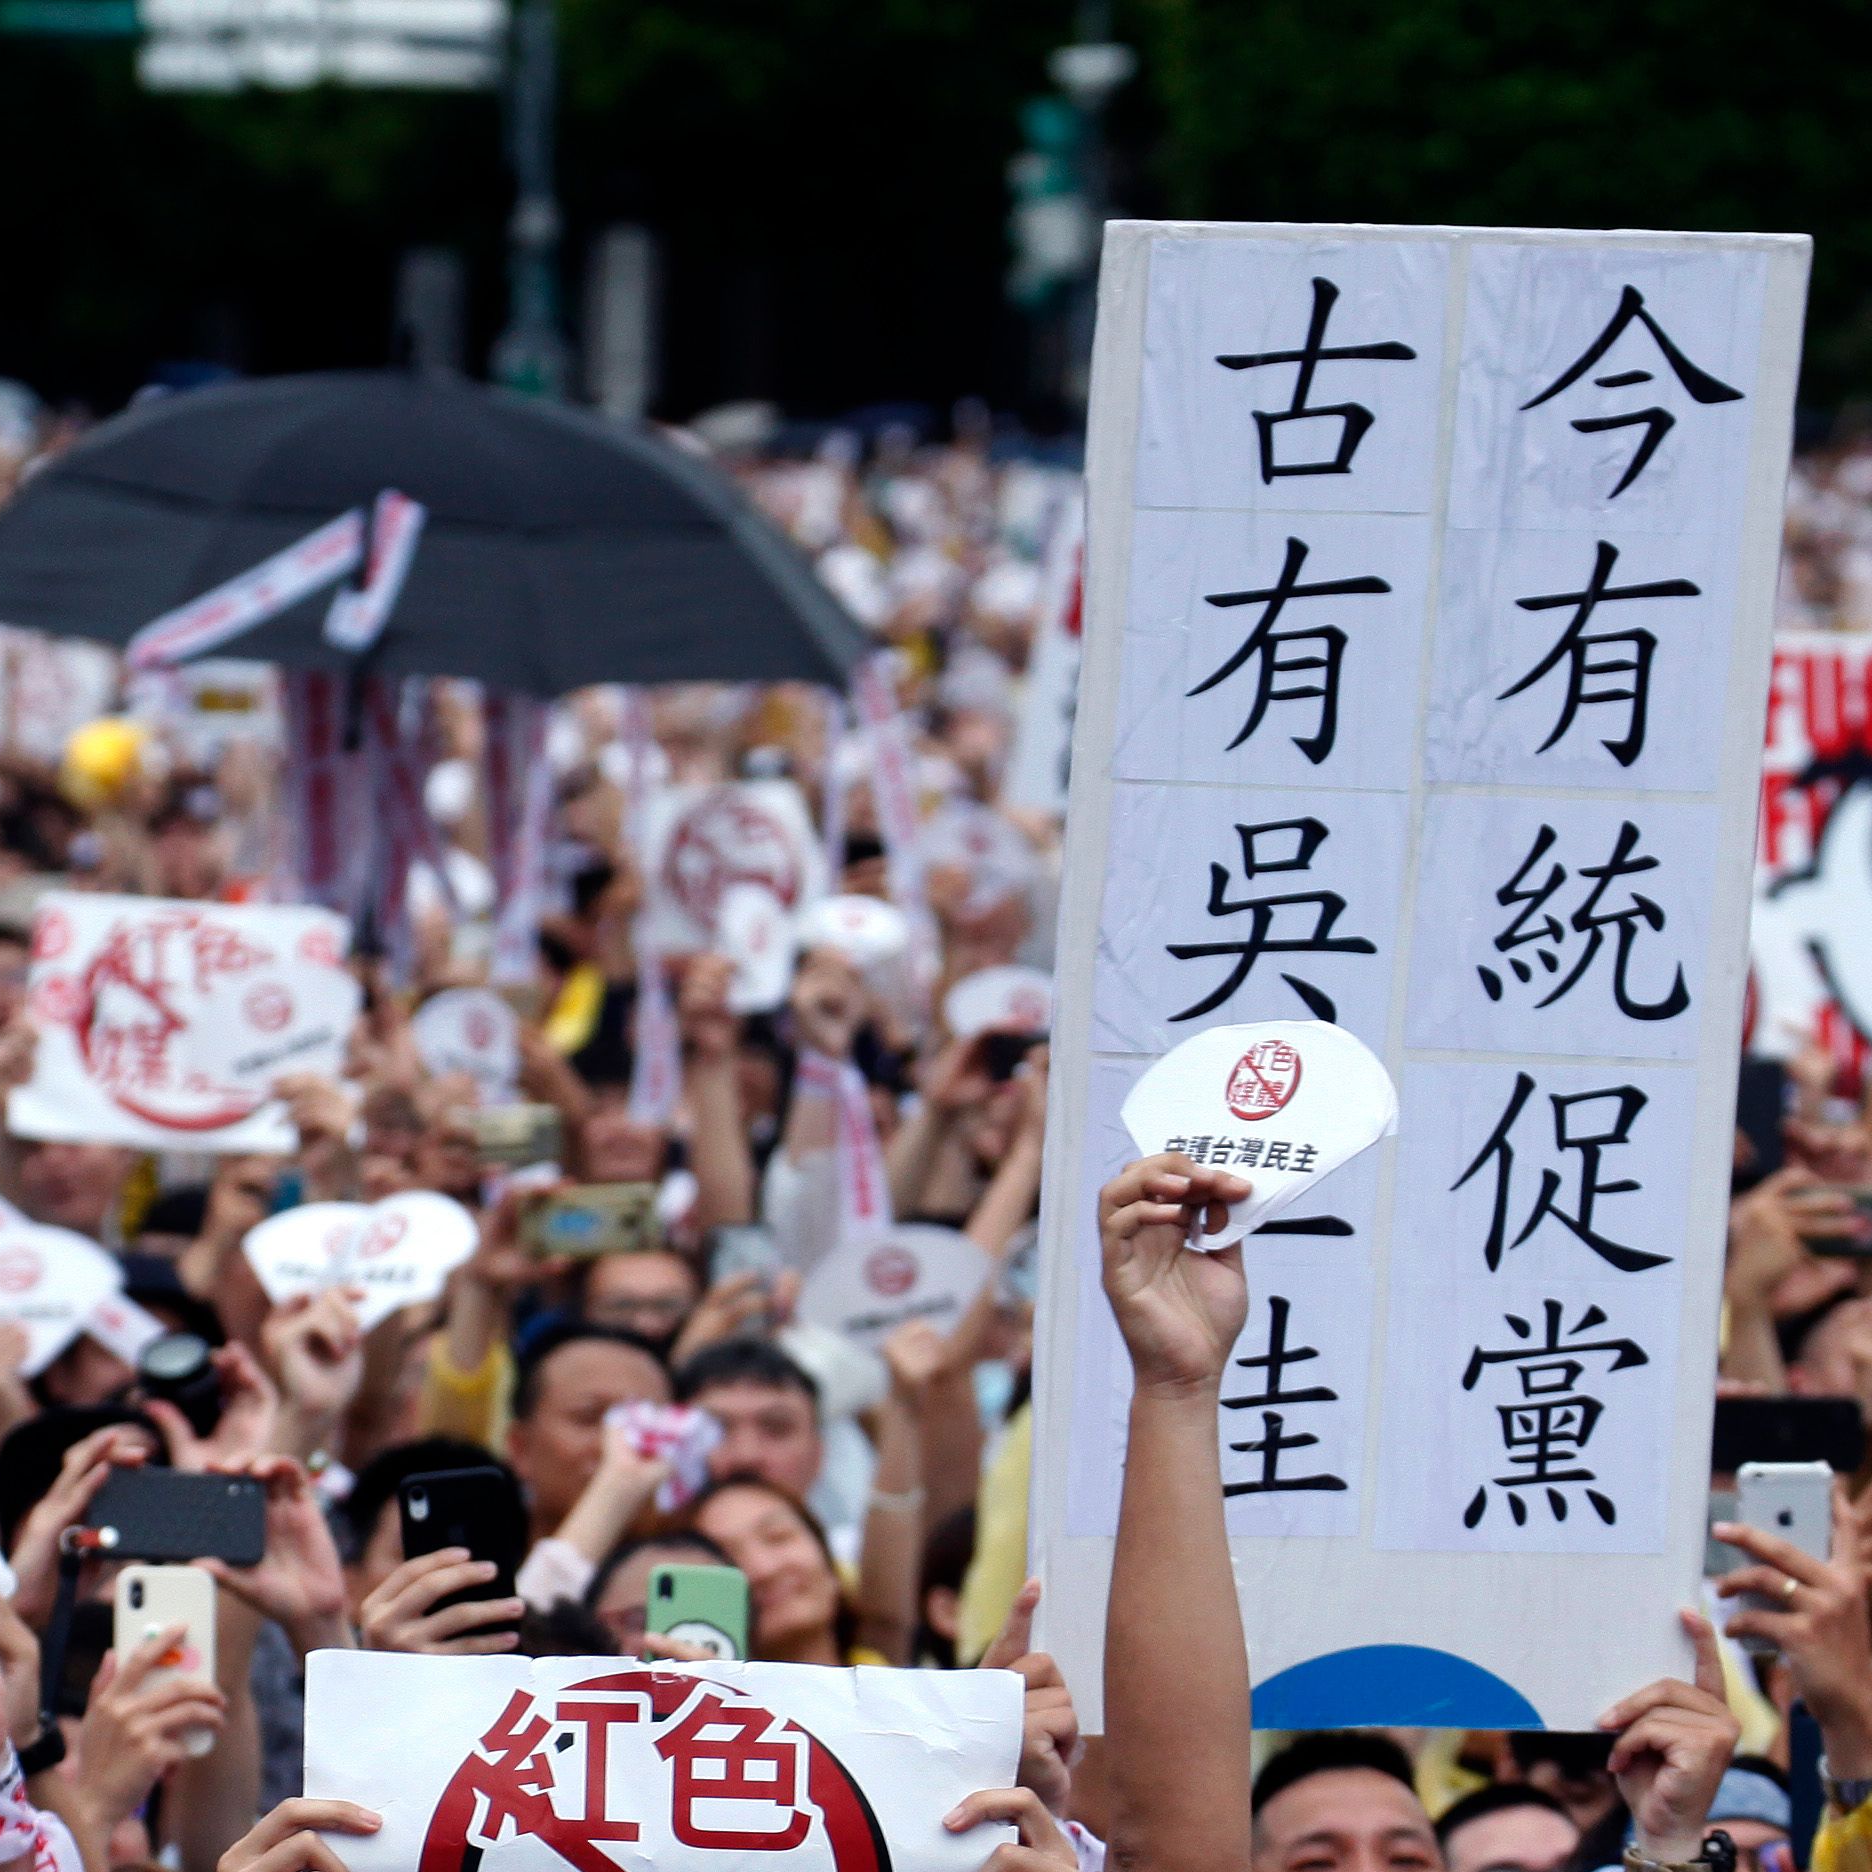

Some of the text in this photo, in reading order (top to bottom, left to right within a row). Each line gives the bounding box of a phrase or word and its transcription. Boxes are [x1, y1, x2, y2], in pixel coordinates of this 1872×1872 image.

[1450, 284, 1746, 1528] 今有統促黨
[473, 1691, 812, 1850] 紅色
